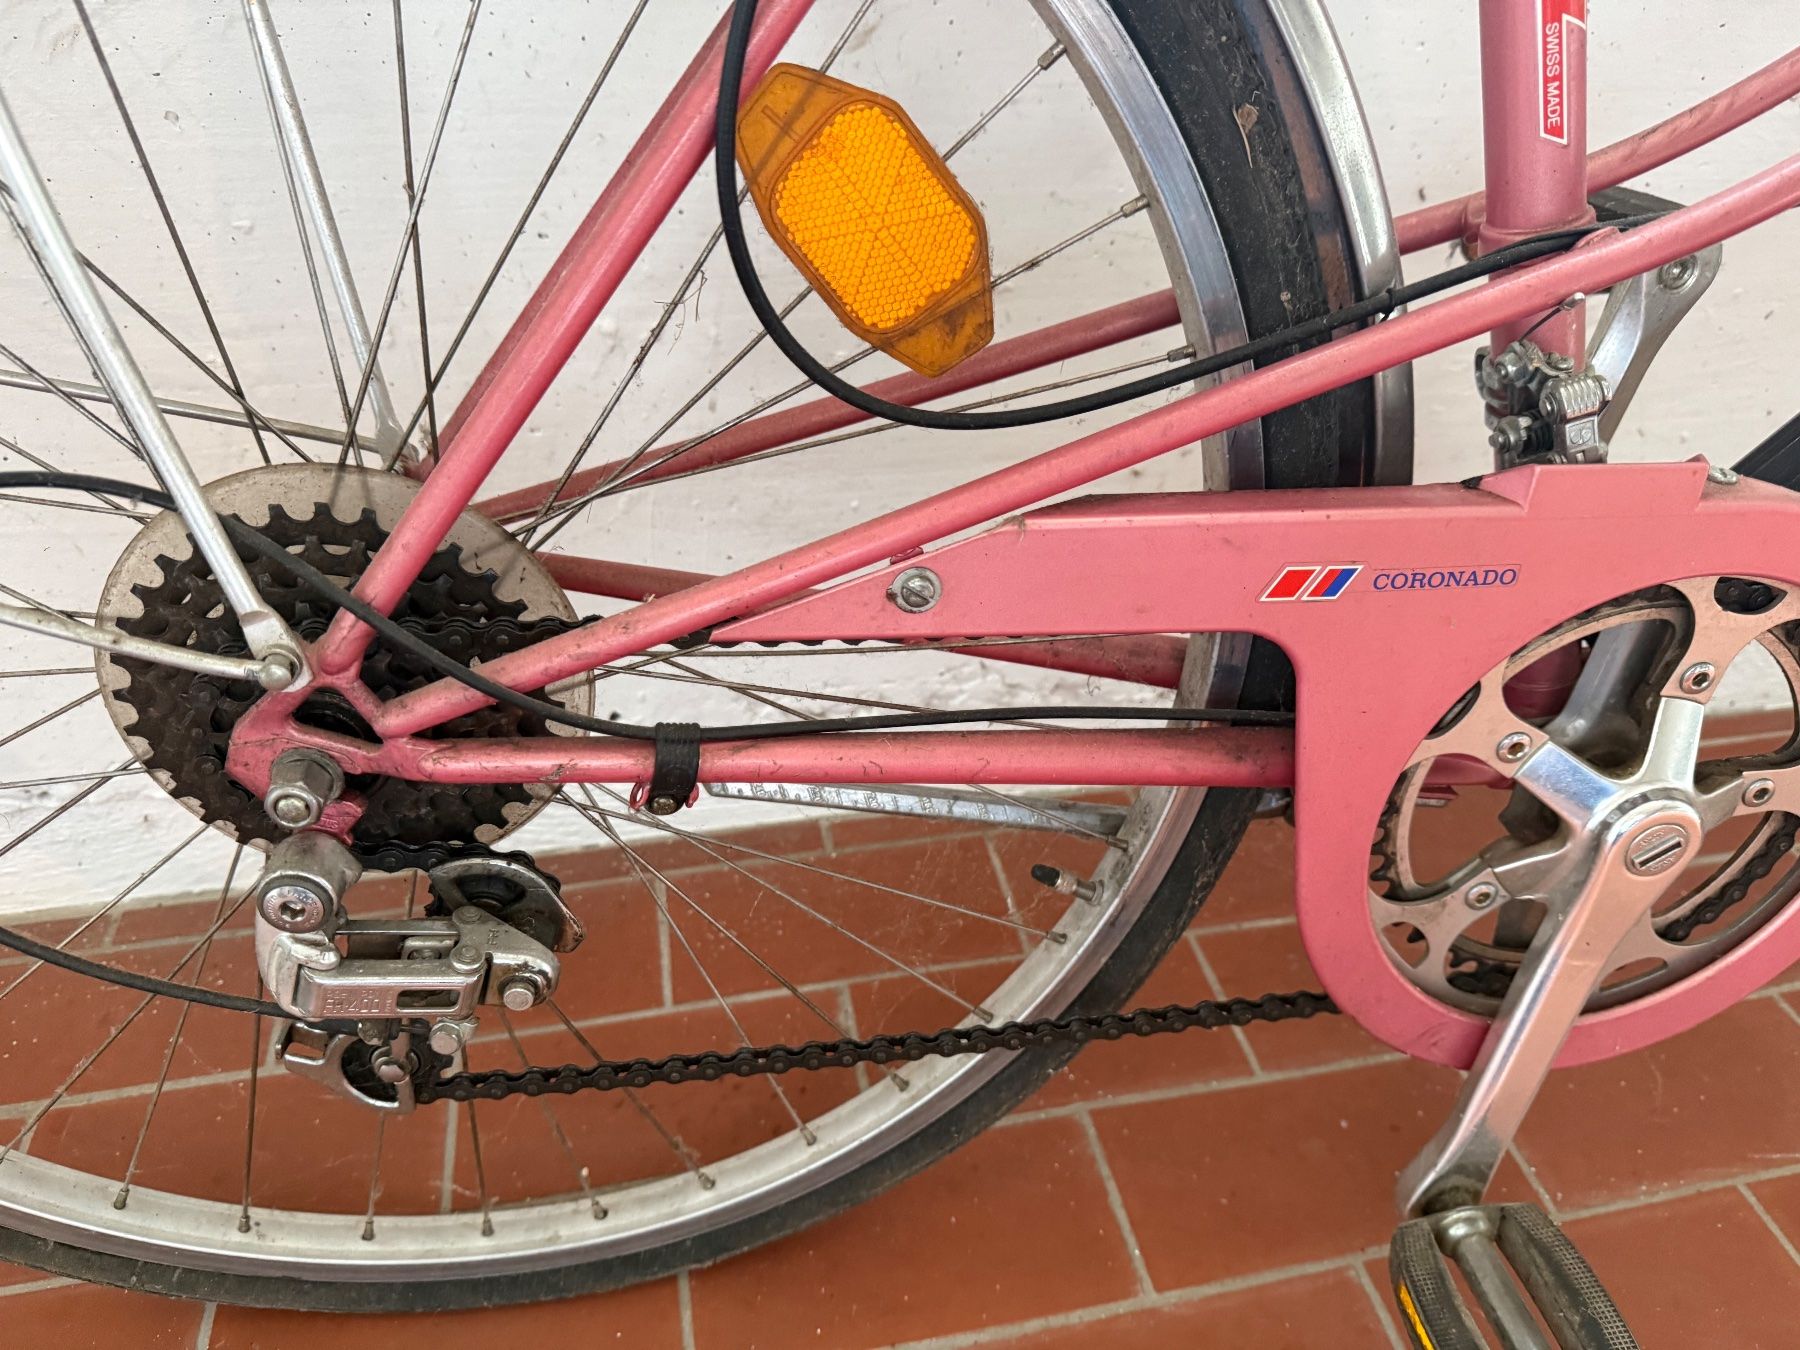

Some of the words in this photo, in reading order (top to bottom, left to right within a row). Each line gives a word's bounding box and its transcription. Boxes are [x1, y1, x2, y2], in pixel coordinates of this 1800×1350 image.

[1545, 22, 1560, 77] SWISS
[1546, 81, 1561, 129] MADE
[1373, 569, 1517, 590] CORONADO
